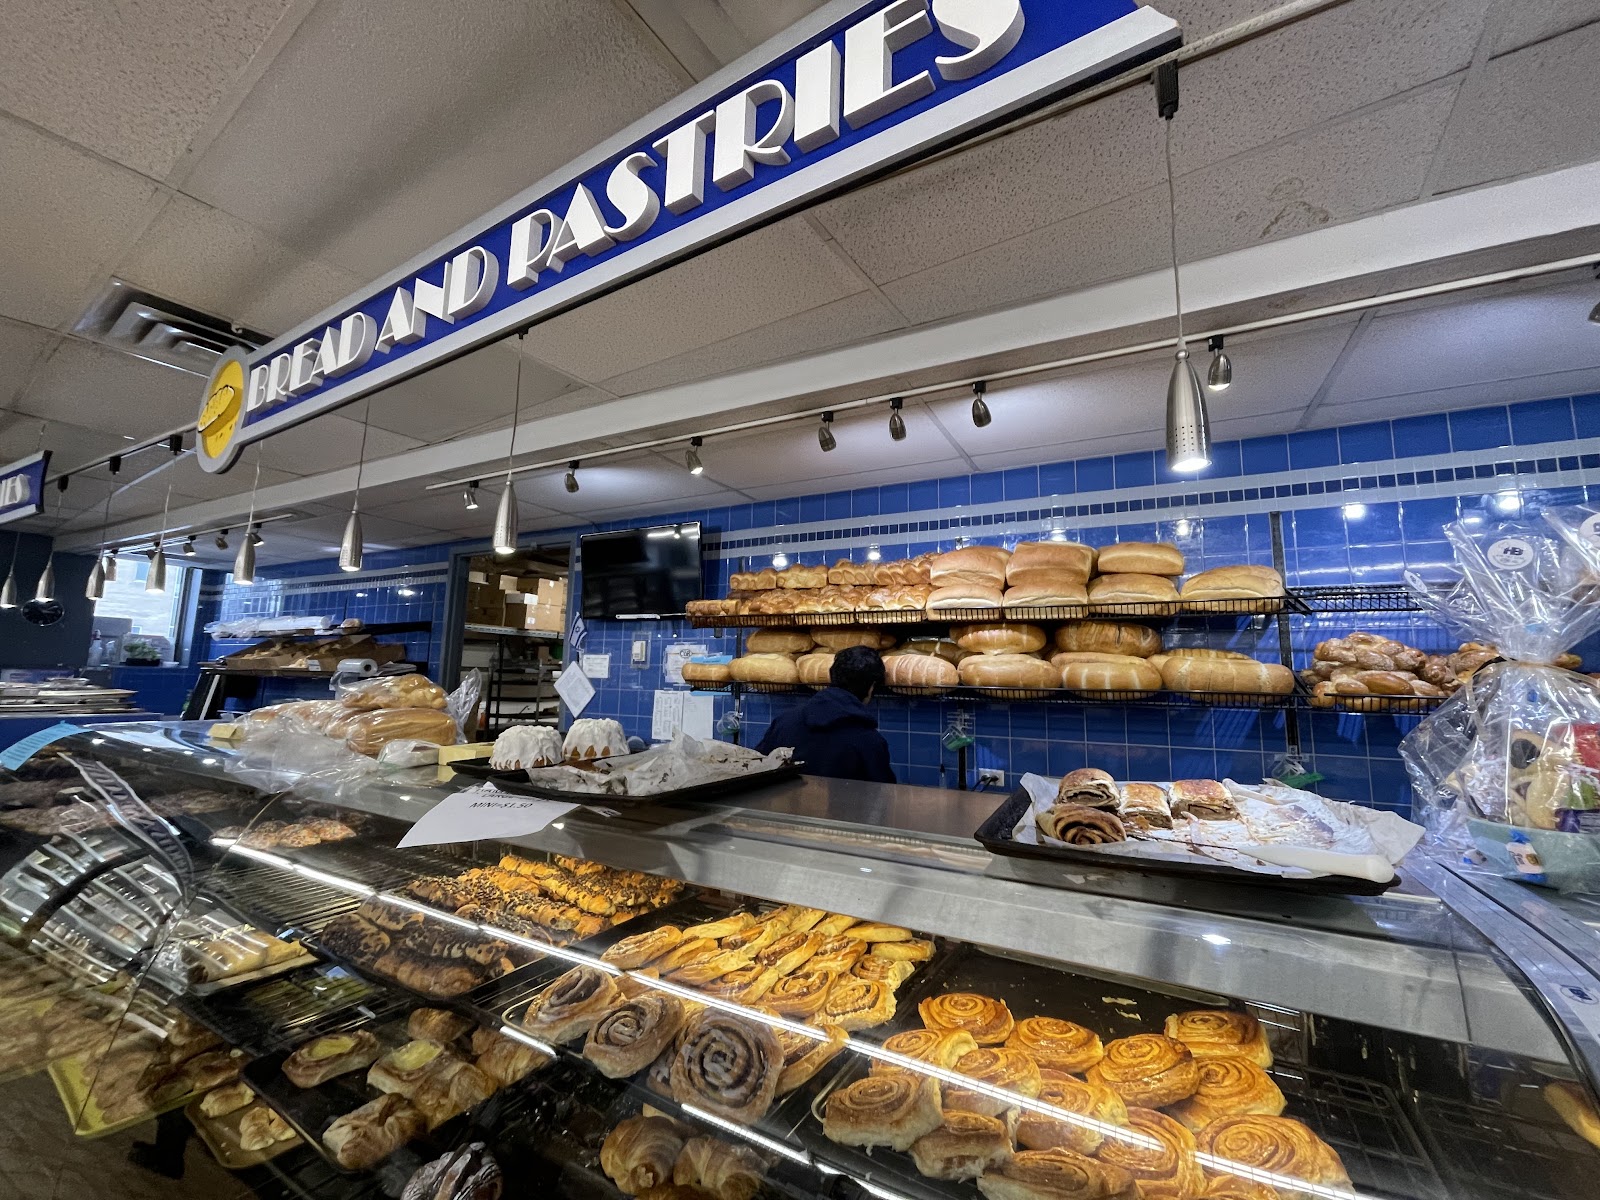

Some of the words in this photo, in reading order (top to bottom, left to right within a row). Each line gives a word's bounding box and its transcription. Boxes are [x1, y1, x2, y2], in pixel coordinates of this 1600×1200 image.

[246, 311, 378, 413] BREAD
[374, 245, 501, 354] AND
[507, 0, 1026, 291] PASTRIES
